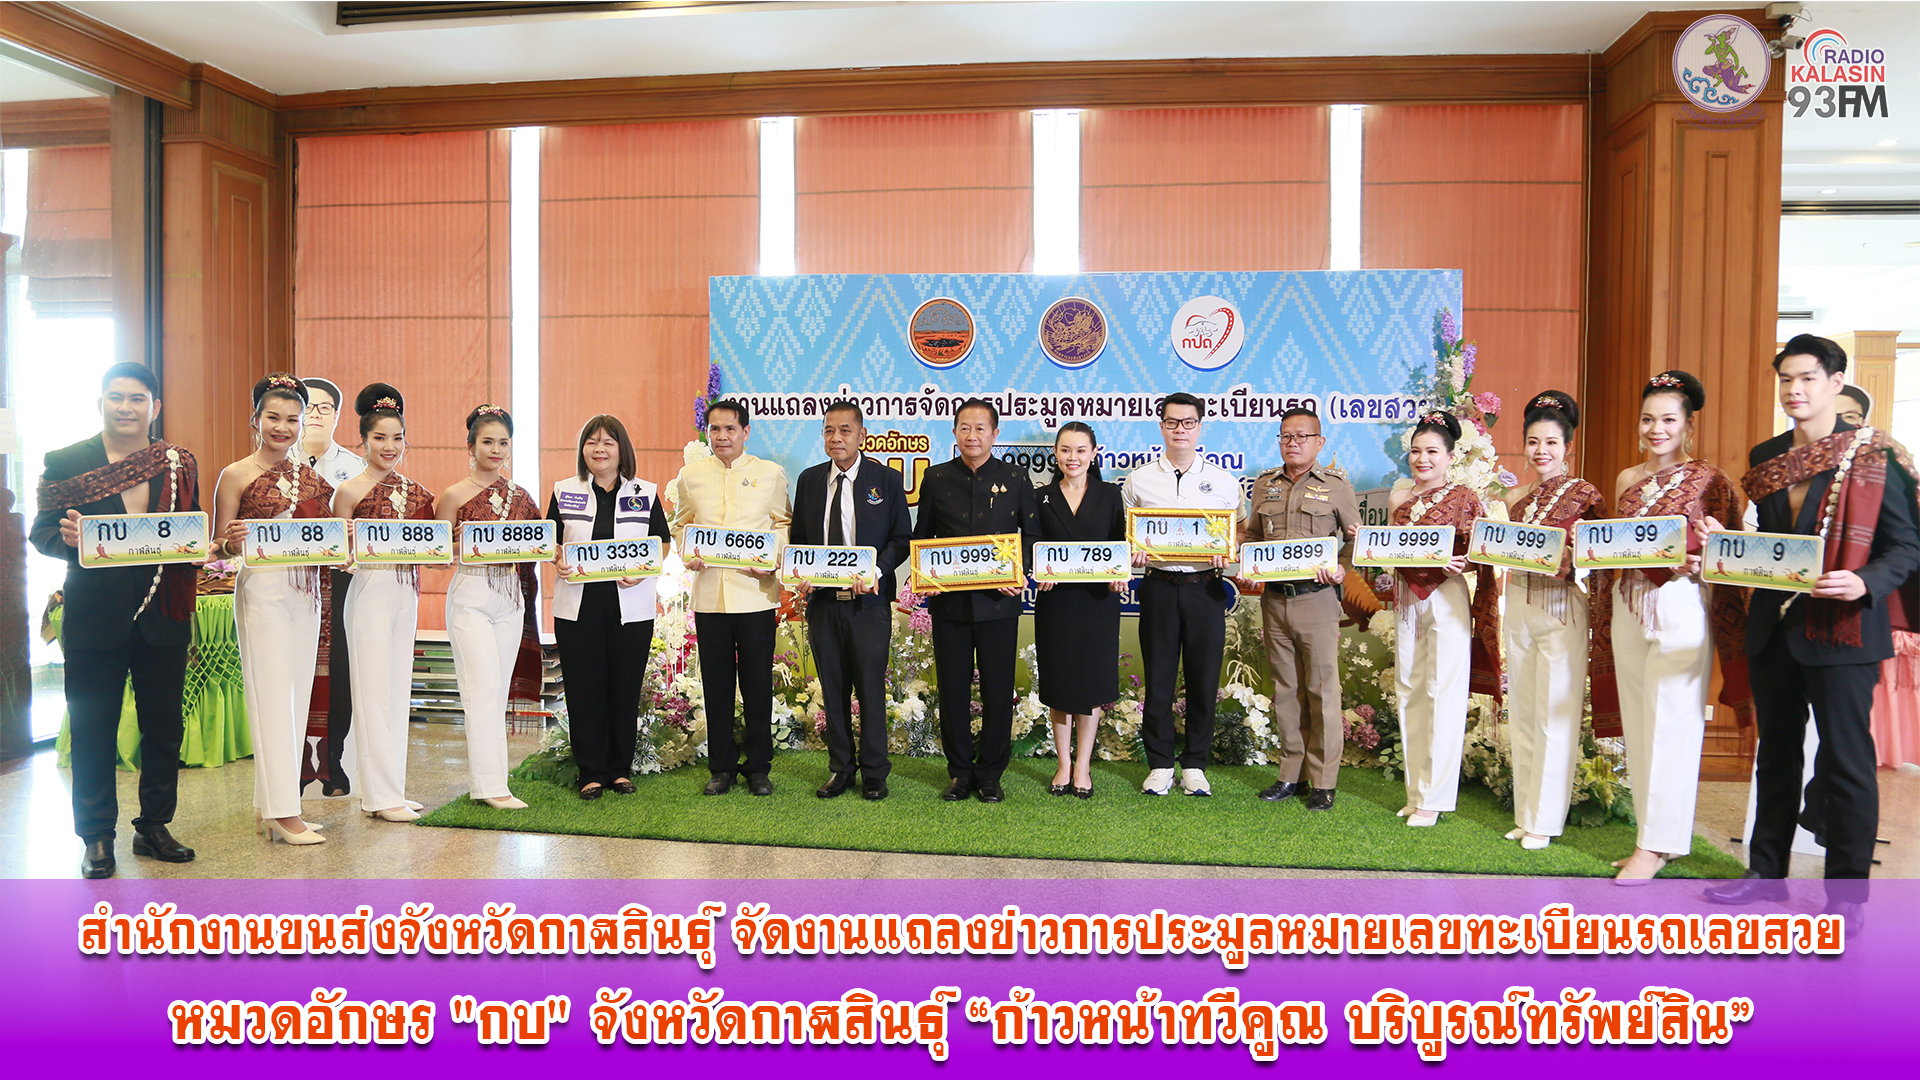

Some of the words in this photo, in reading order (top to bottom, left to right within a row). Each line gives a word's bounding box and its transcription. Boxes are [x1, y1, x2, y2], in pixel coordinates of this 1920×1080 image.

[1182, 335, 1212, 350] กปถ
[97, 522, 127, 542] กบ
[157, 520, 171, 538] 8
[257, 525, 281, 543] กบ
[301, 525, 324, 542] 88
[367, 525, 390, 542] กบ
[402, 526, 434, 542] 888
[473, 527, 494, 543] กบ
[502, 526, 544, 542] 8888
[1146, 520, 1169, 536] กบ
[1192, 520, 1200, 536] 1
[1483, 524, 1505, 543] กบ
[1515, 529, 1547, 549] 999
[1587, 525, 1613, 544] กบ
[1634, 524, 1659, 542] 99
[695, 530, 717, 546] กบ
[725, 532, 765, 550] 6666
[1368, 529, 1391, 547] กบ
[1398, 530, 1440, 548] 9999
[577, 545, 599, 562] กบ
[606, 542, 649, 560] 3333
[793, 549, 815, 566] กบ
[827, 551, 858, 567] 222
[930, 550, 952, 566] กบ
[1047, 547, 1069, 562] กบ
[1081, 547, 1112, 562] 789
[1252, 546, 1275, 563] กบ
[1282, 543, 1324, 560] 8899
[1718, 537, 1746, 560] กบ
[1771, 541, 1785, 562] 9
